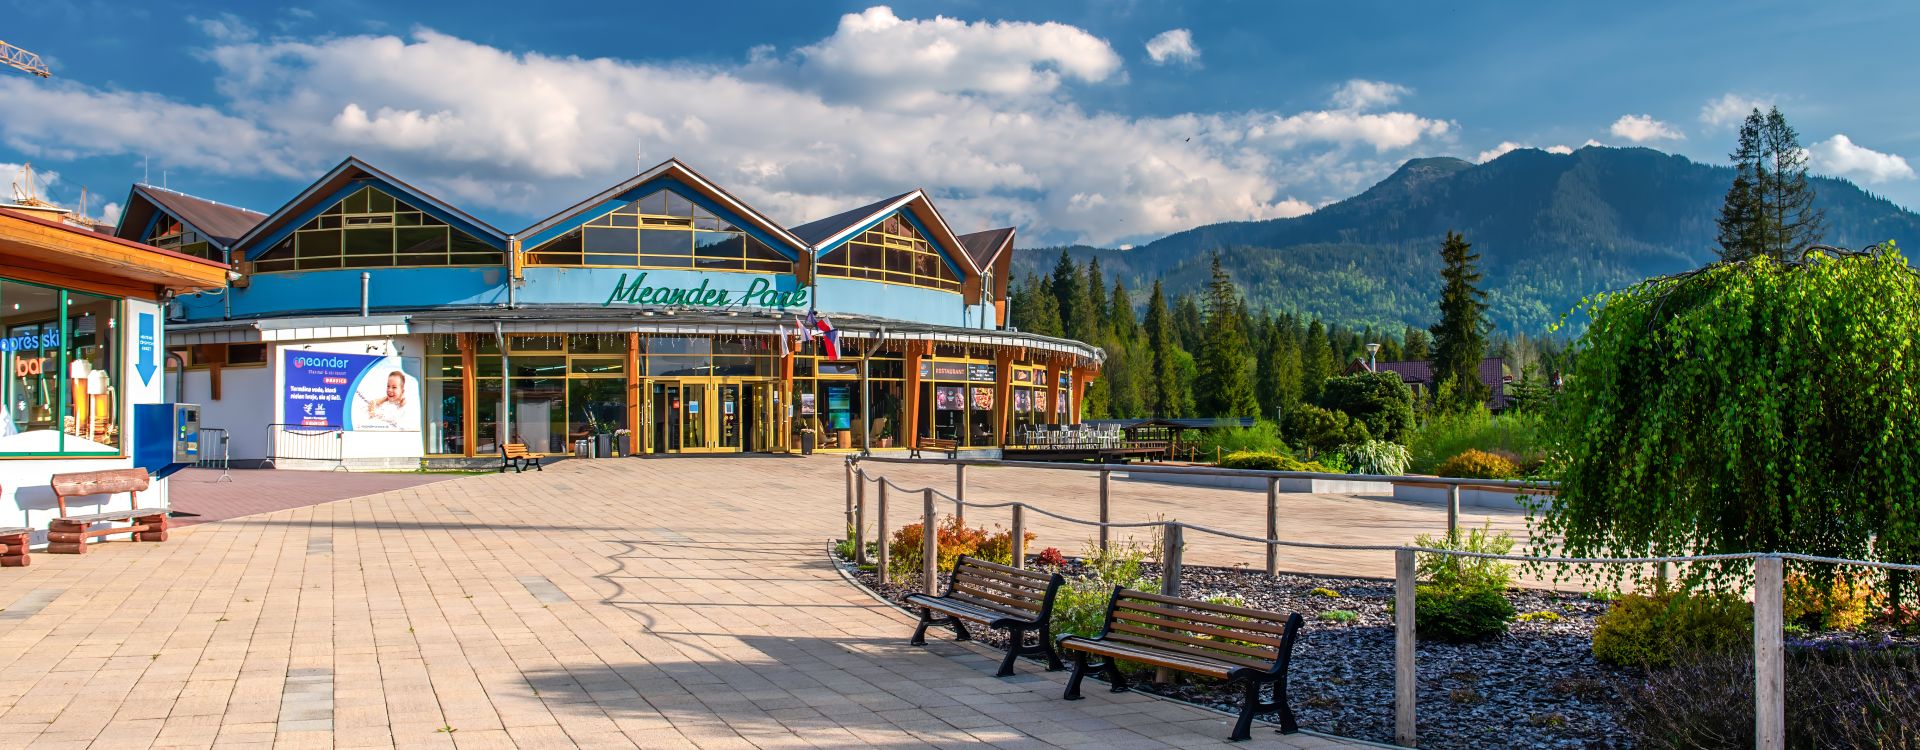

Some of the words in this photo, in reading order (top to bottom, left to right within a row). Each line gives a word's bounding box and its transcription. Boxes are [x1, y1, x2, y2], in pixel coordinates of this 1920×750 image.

[601, 272, 732, 306] Meander
[742, 277, 808, 307] Park
[0, 331, 39, 352] après
[42, 329, 60, 348] ski
[16, 356, 45, 377] bar
